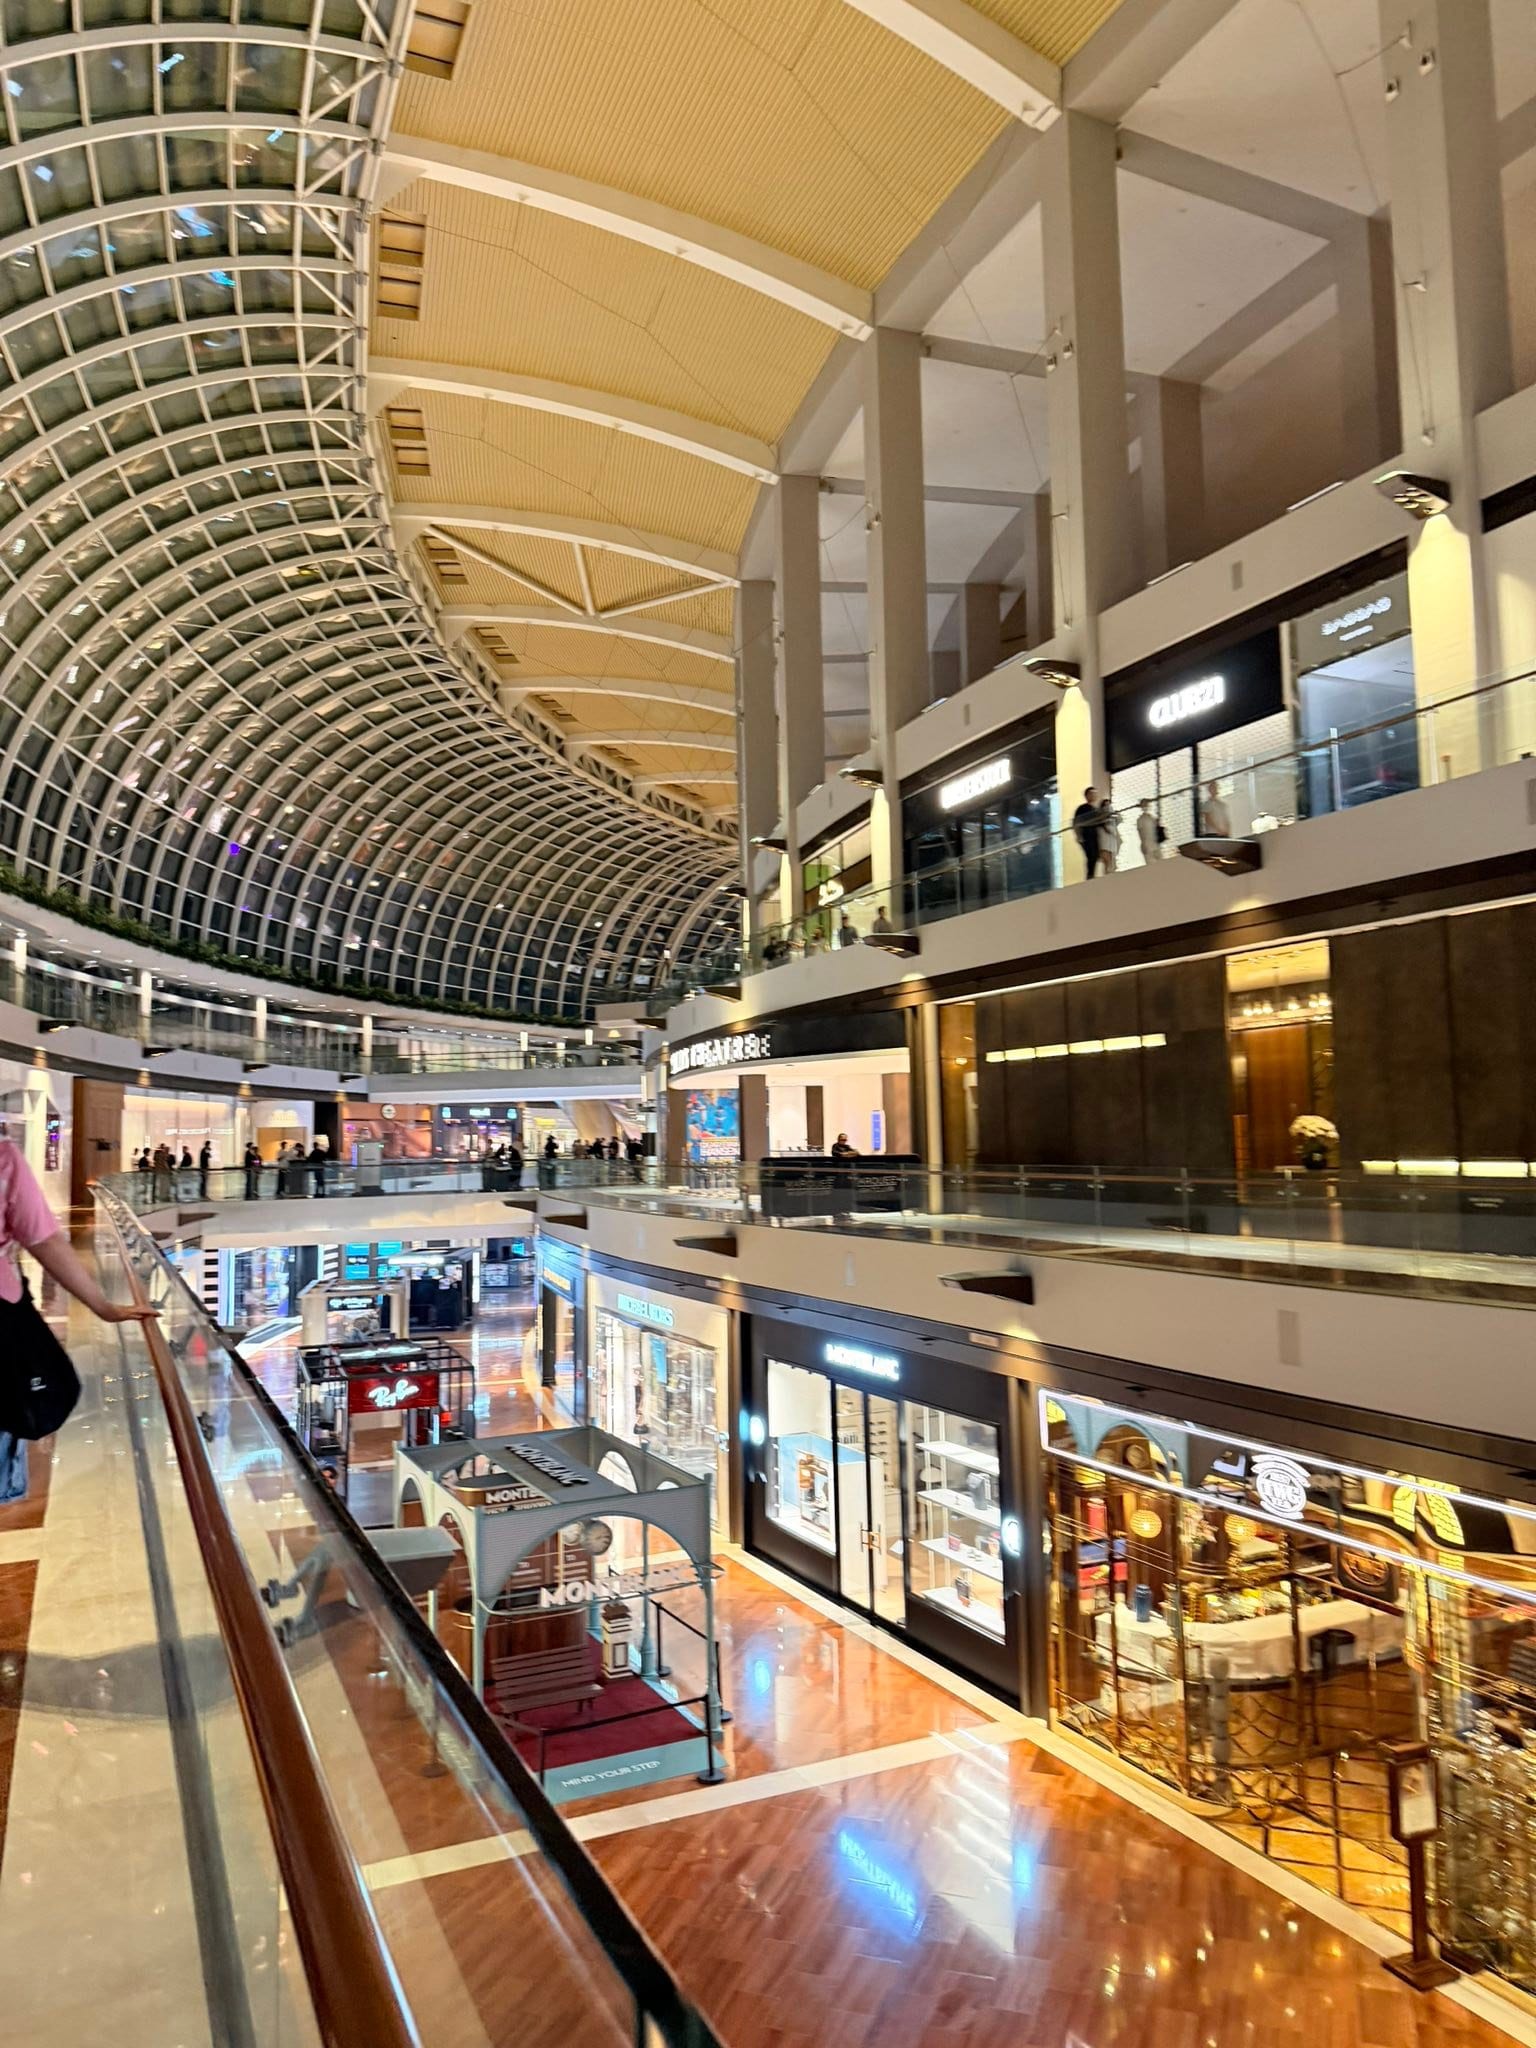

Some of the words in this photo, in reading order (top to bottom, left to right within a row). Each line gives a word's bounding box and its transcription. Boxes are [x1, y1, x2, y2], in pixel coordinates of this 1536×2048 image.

[561, 1774, 596, 1788] MIND
[596, 1767, 631, 1779] YOUR
[631, 1761, 661, 1772] STEP
